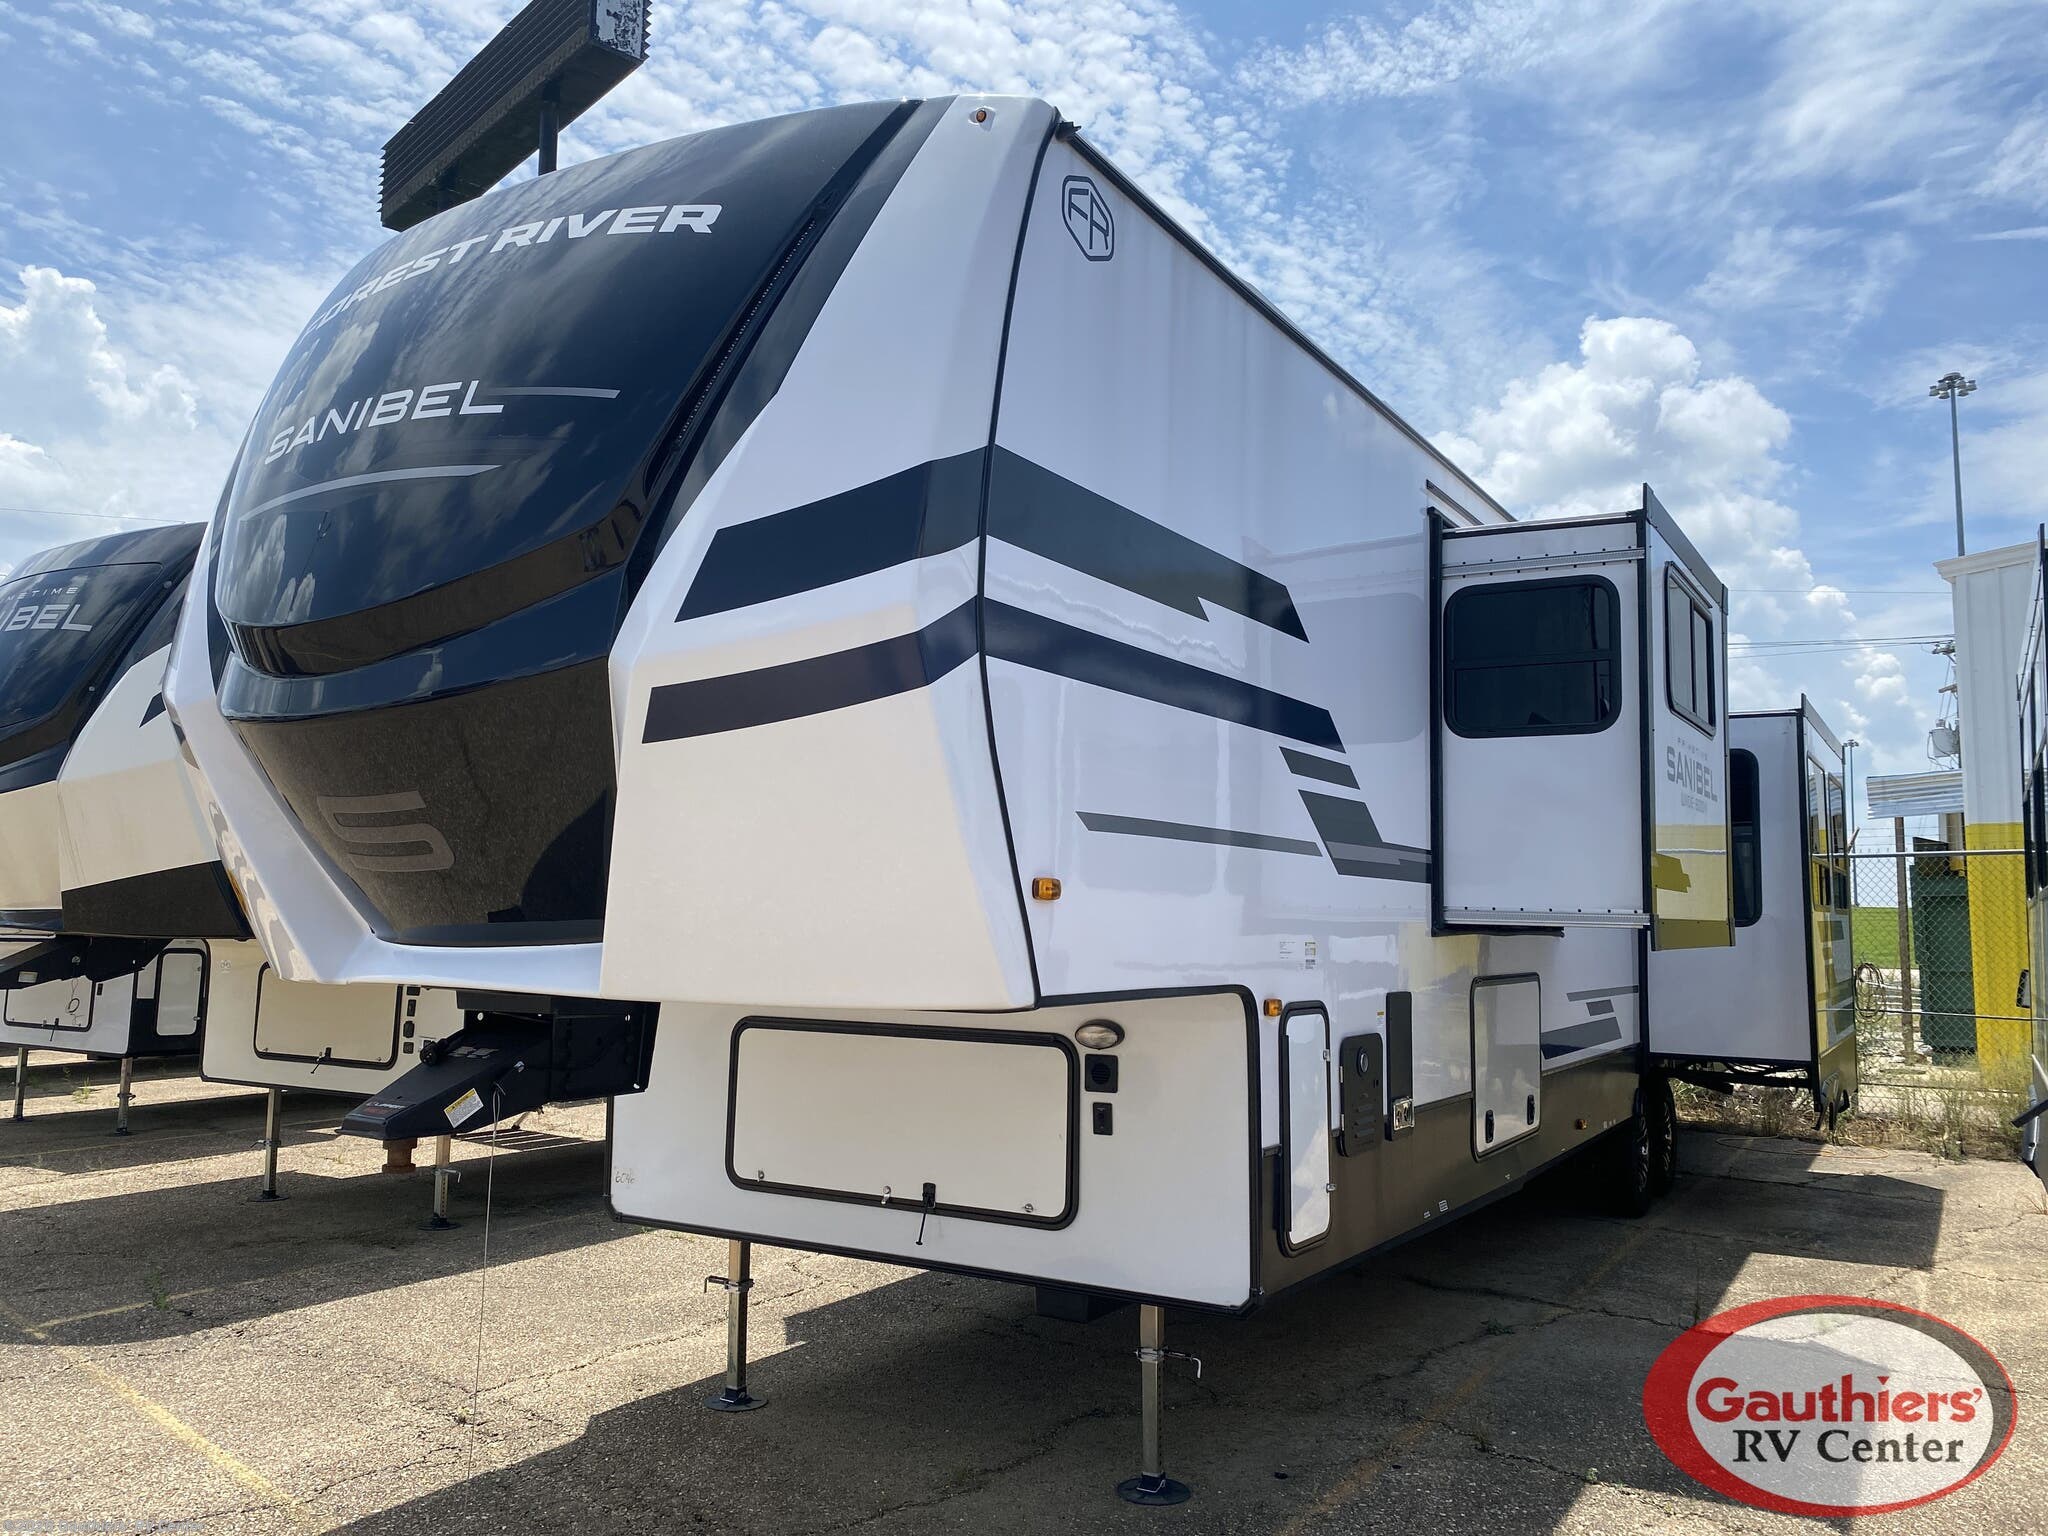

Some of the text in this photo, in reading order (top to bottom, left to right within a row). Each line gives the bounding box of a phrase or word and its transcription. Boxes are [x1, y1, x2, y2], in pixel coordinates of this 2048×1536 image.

[489, 203, 723, 253] RIVER
[264, 379, 504, 465] SANIBEL
[1666, 745, 1718, 802] SANIBEL
